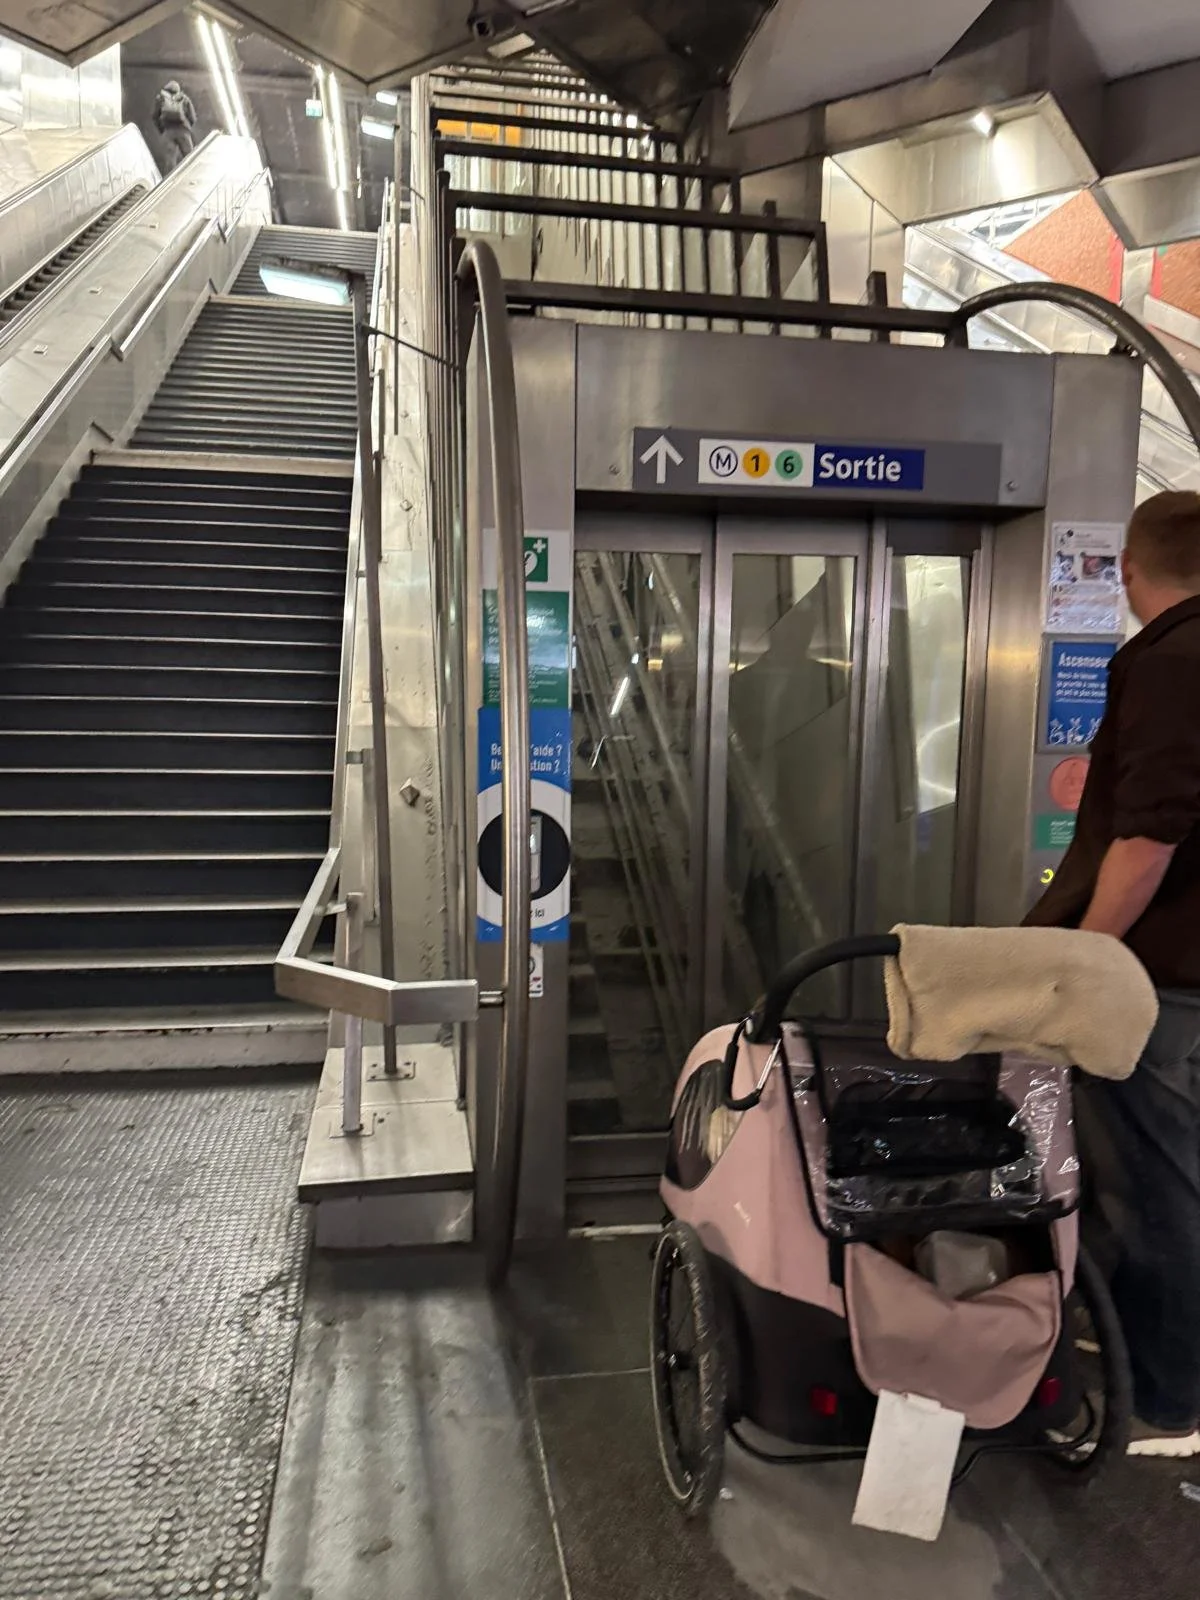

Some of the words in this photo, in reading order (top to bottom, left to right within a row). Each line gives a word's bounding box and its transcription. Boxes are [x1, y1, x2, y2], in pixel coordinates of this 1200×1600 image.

[750, 453, 761, 473] 1
[782, 455, 795, 475] 6
[818, 451, 902, 483] Sortie
[530, 743, 554, 757] 'aide
